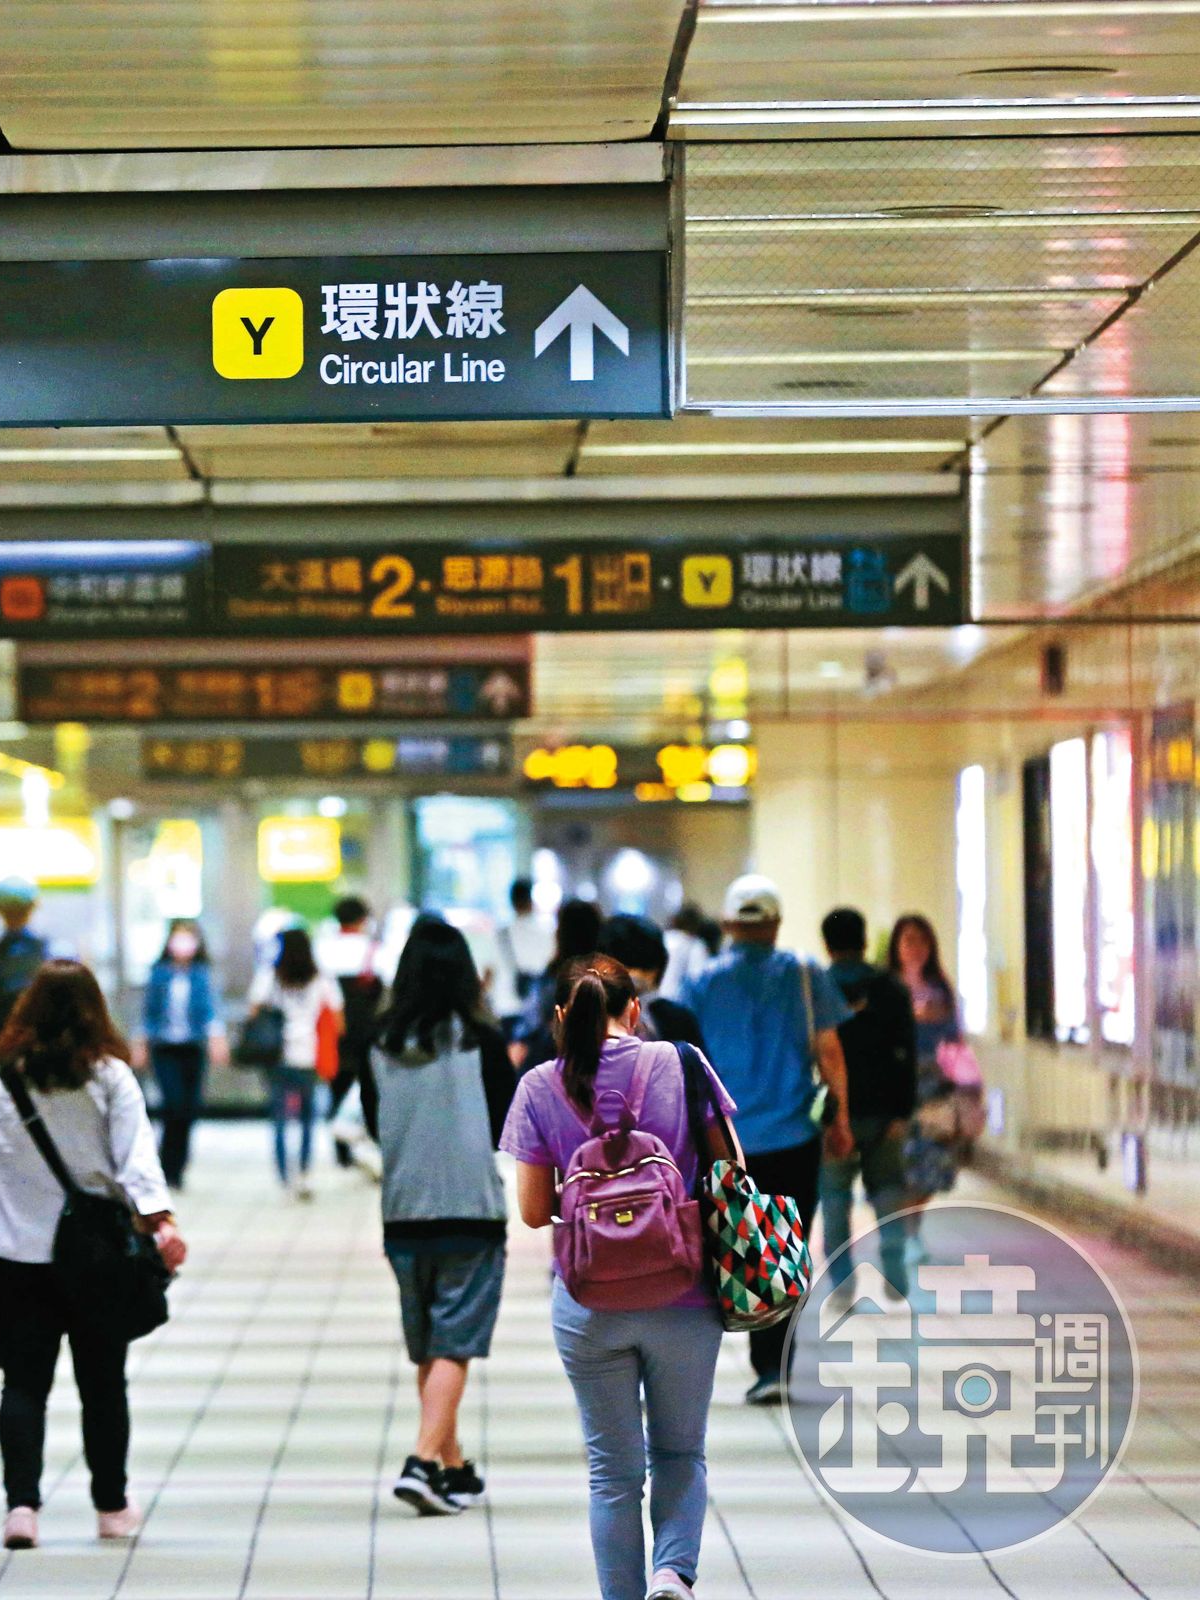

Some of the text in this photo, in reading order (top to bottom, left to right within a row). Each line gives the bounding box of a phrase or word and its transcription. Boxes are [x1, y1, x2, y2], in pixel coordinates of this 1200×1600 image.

[240, 316, 275, 356] Y
[320, 280, 507, 342] 環狀線
[319, 353, 506, 385] Circular Line
[369, 554, 416, 619] 2
[553, 553, 583, 616] 1
